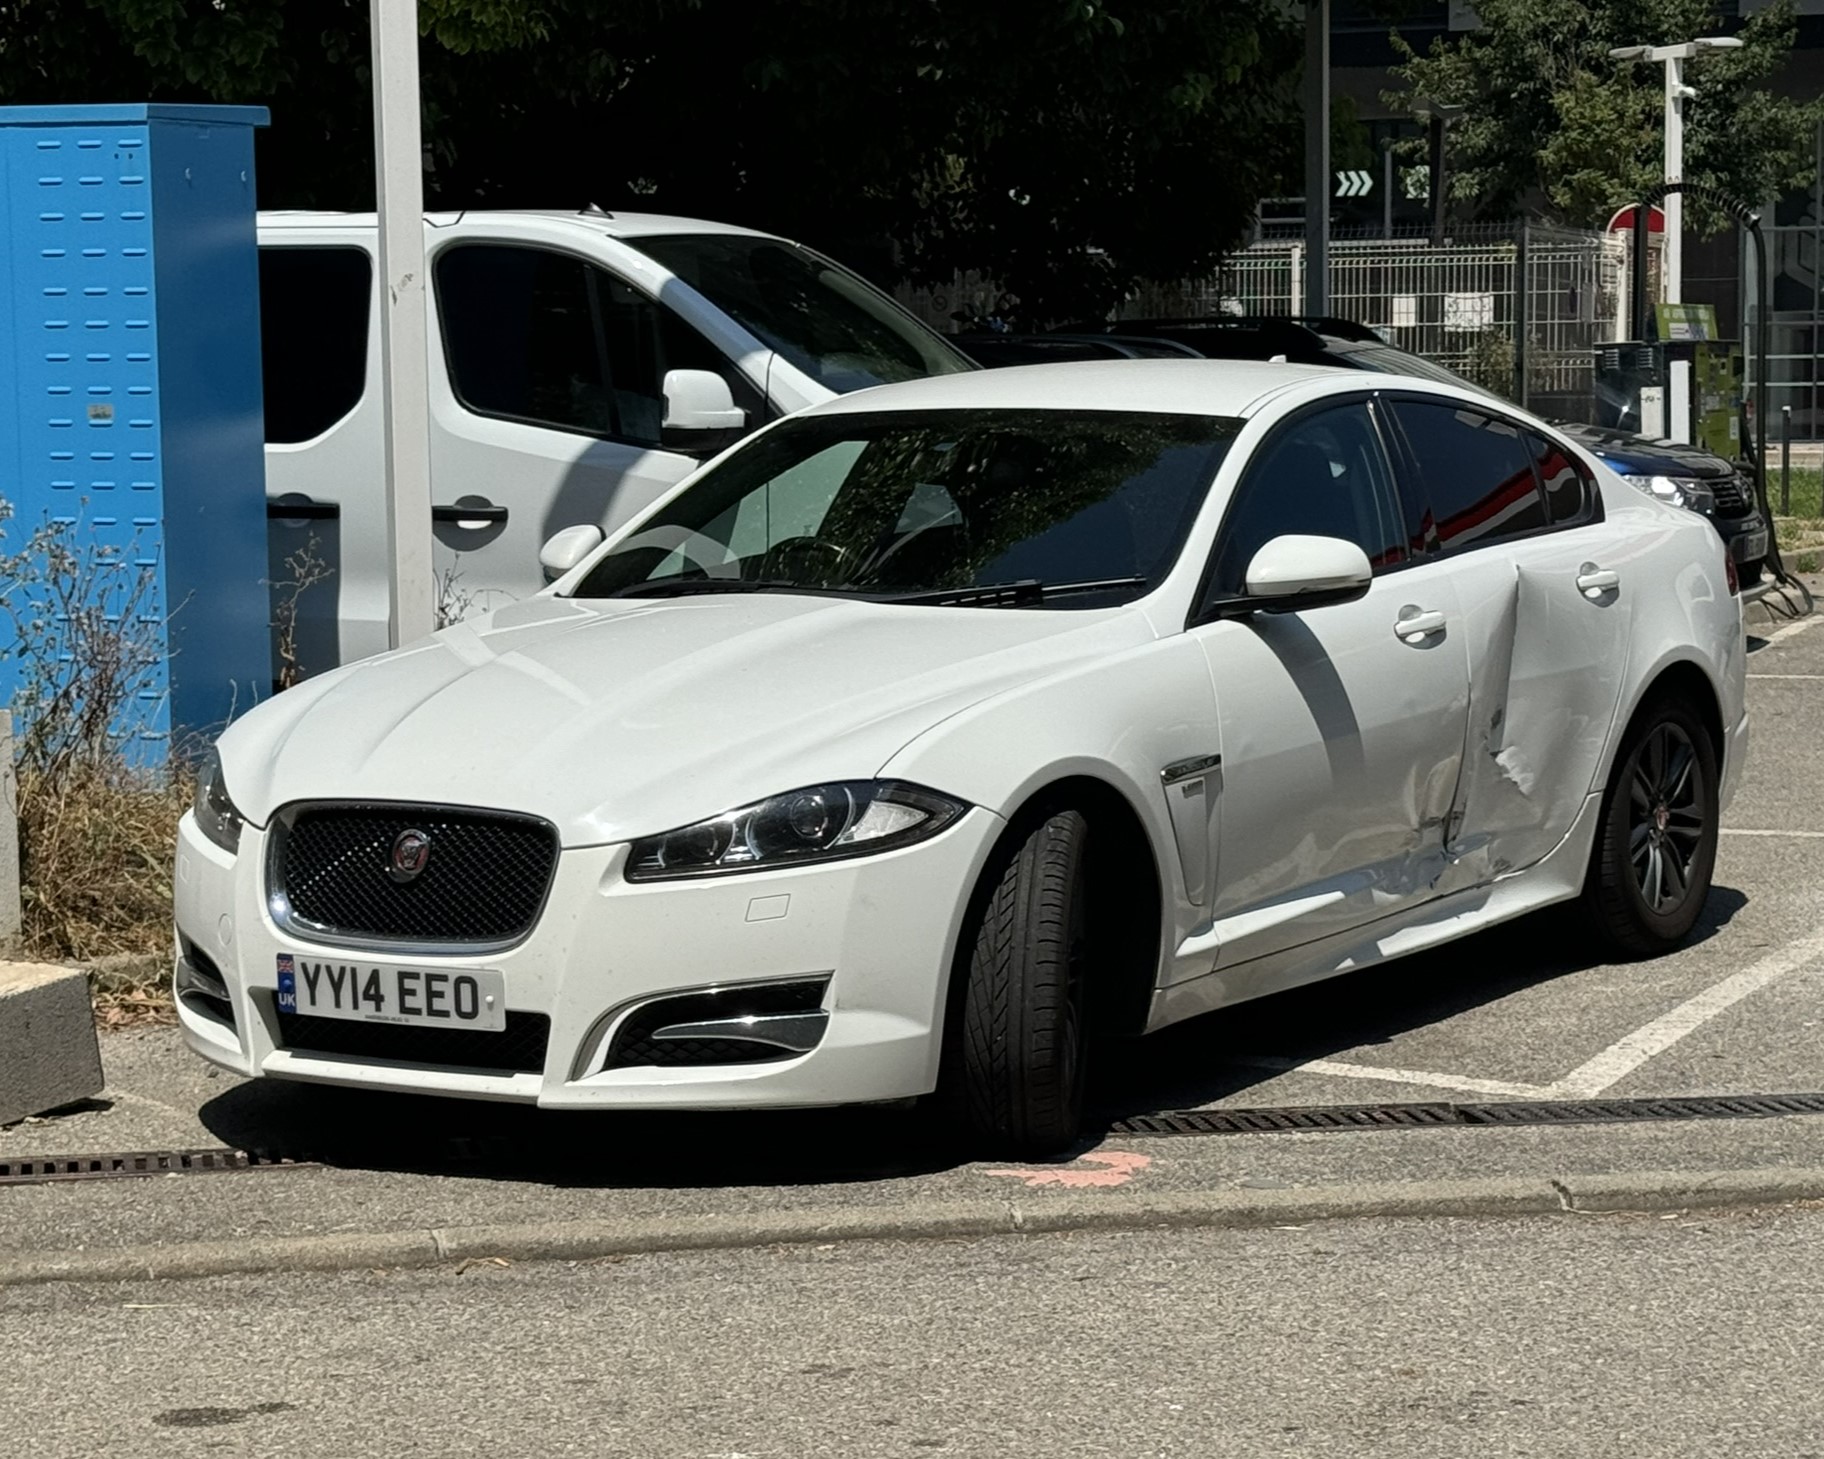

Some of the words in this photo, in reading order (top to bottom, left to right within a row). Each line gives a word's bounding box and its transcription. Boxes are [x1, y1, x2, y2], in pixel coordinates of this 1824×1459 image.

[279, 992, 295, 1007] UK
[301, 962, 385, 1012] YY14
[397, 970, 479, 1020] EEO
